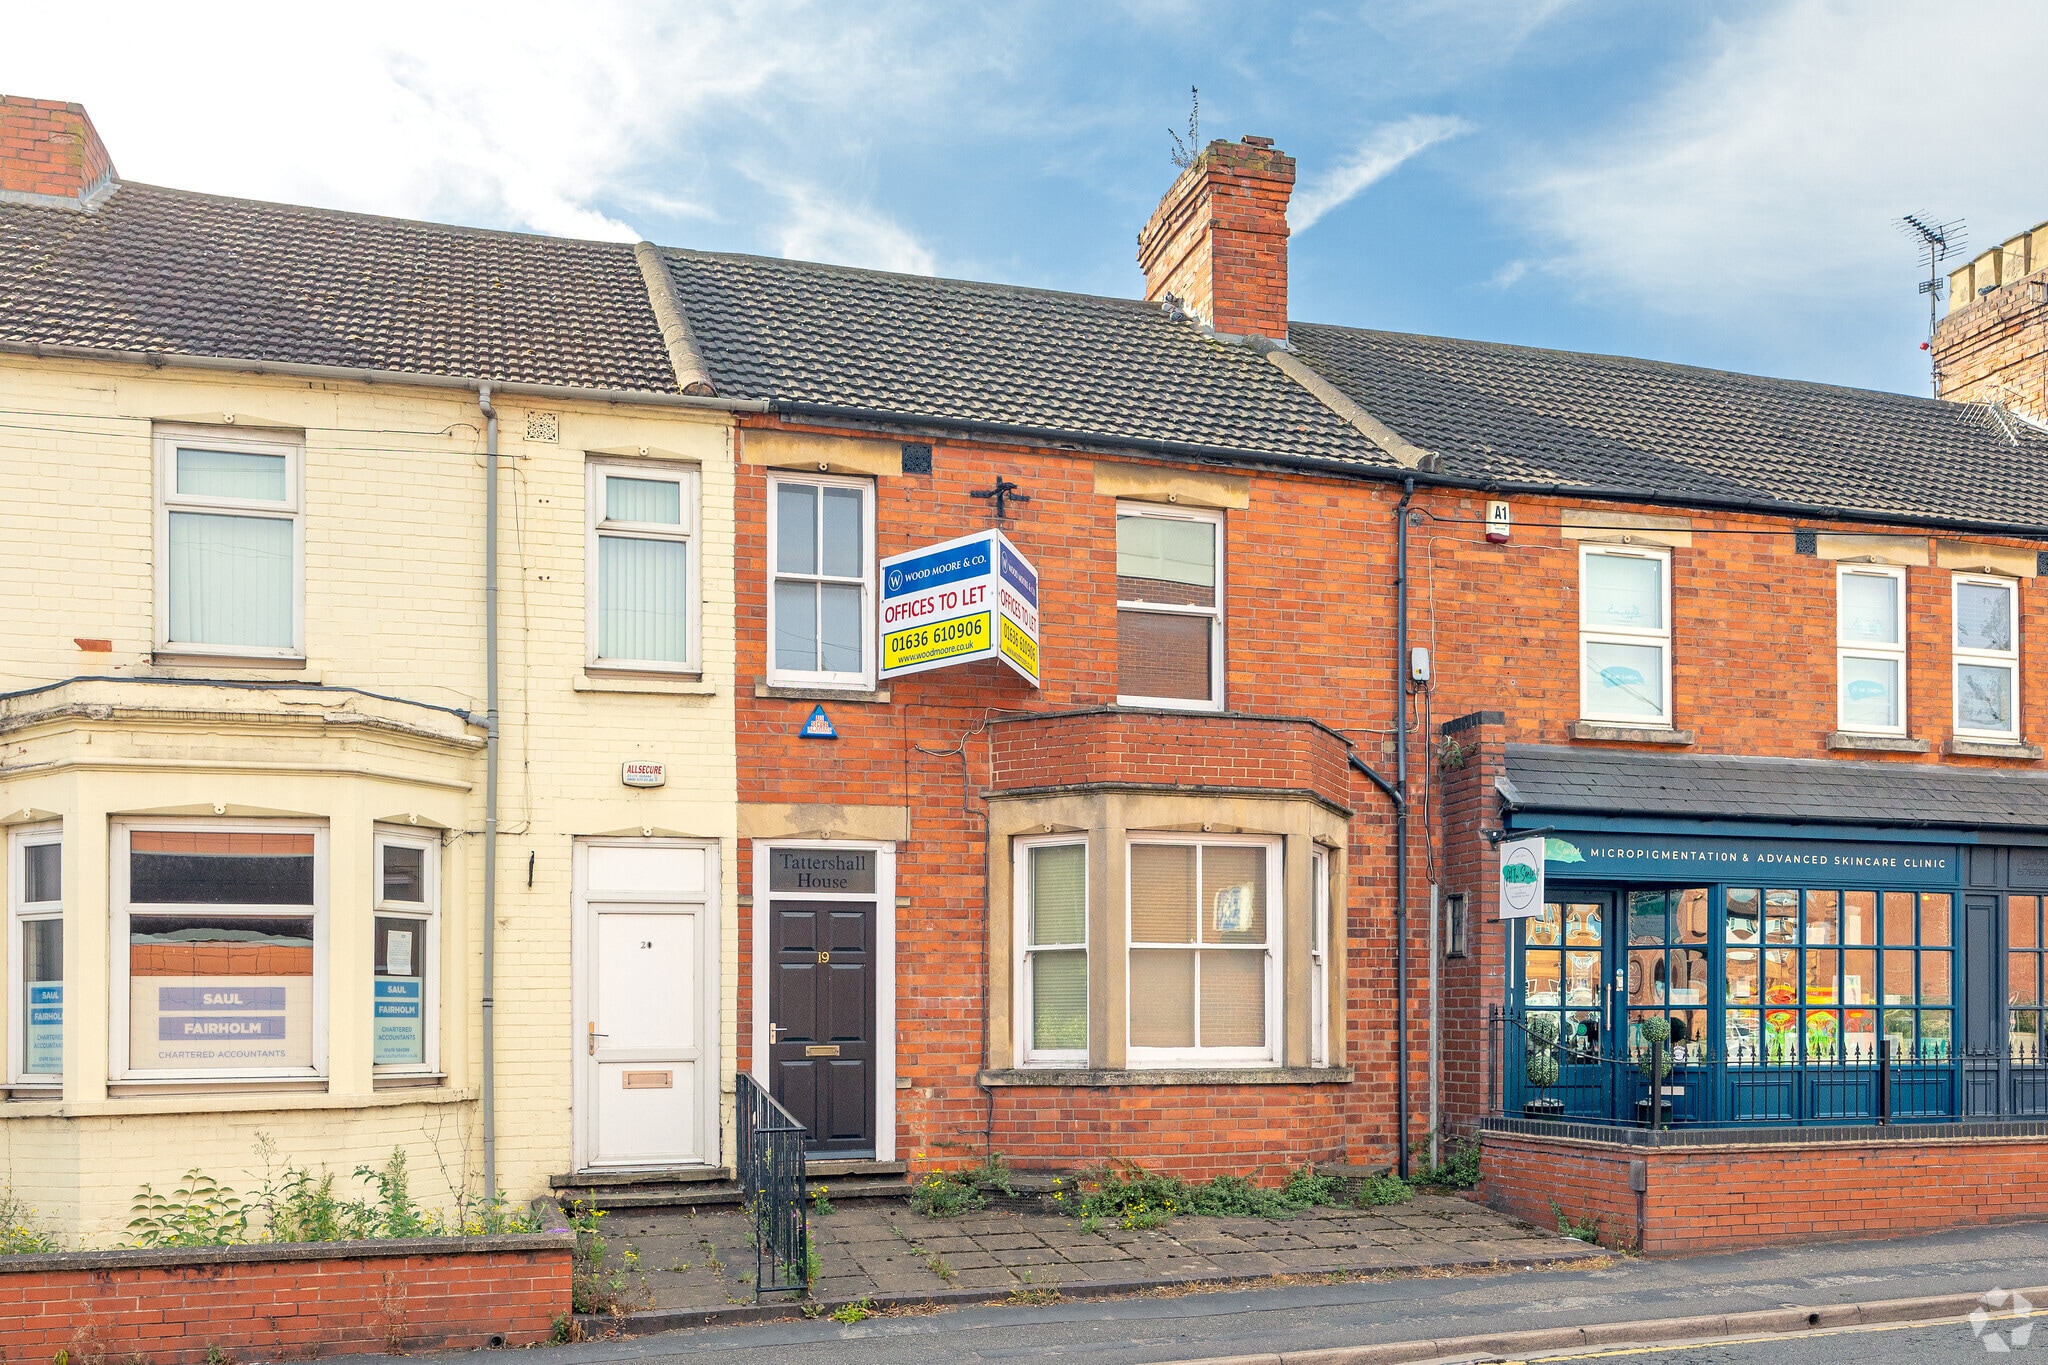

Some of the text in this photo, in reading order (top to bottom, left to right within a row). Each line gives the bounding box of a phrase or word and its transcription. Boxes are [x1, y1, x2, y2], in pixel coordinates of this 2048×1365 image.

[1495, 505, 1507, 520] A1
[905, 555, 987, 582] WOOD MOORE & CO.
[884, 585, 987, 624] OFFICES TO LET
[1000, 588, 1037, 634] OFFICES TO LET
[891, 619, 982, 653] 01636 610906
[1003, 622, 1019, 647] 01636
[897, 640, 974, 663] www.woodmoore.co.uk
[627, 765, 662, 775] ALLSECURE
[779, 853, 866, 871] Tattershall
[1590, 848, 1946, 869] MICROPIGMENTATION & ADVANCED SKINCARE CLINIC
[797, 873, 848, 889] House
[817, 951, 830, 963] 19
[42, 991, 59, 999] SAUL
[387, 985, 407, 994] SAUL
[203, 993, 244, 1005] SAUL
[34, 1012, 63, 1021] FAIRHOL
[378, 1005, 416, 1014] FAIRHOLM
[184, 1022, 262, 1034] FAIRHOLM
[158, 1049, 286, 1059] CHARTERED ACCOUNTANTS
